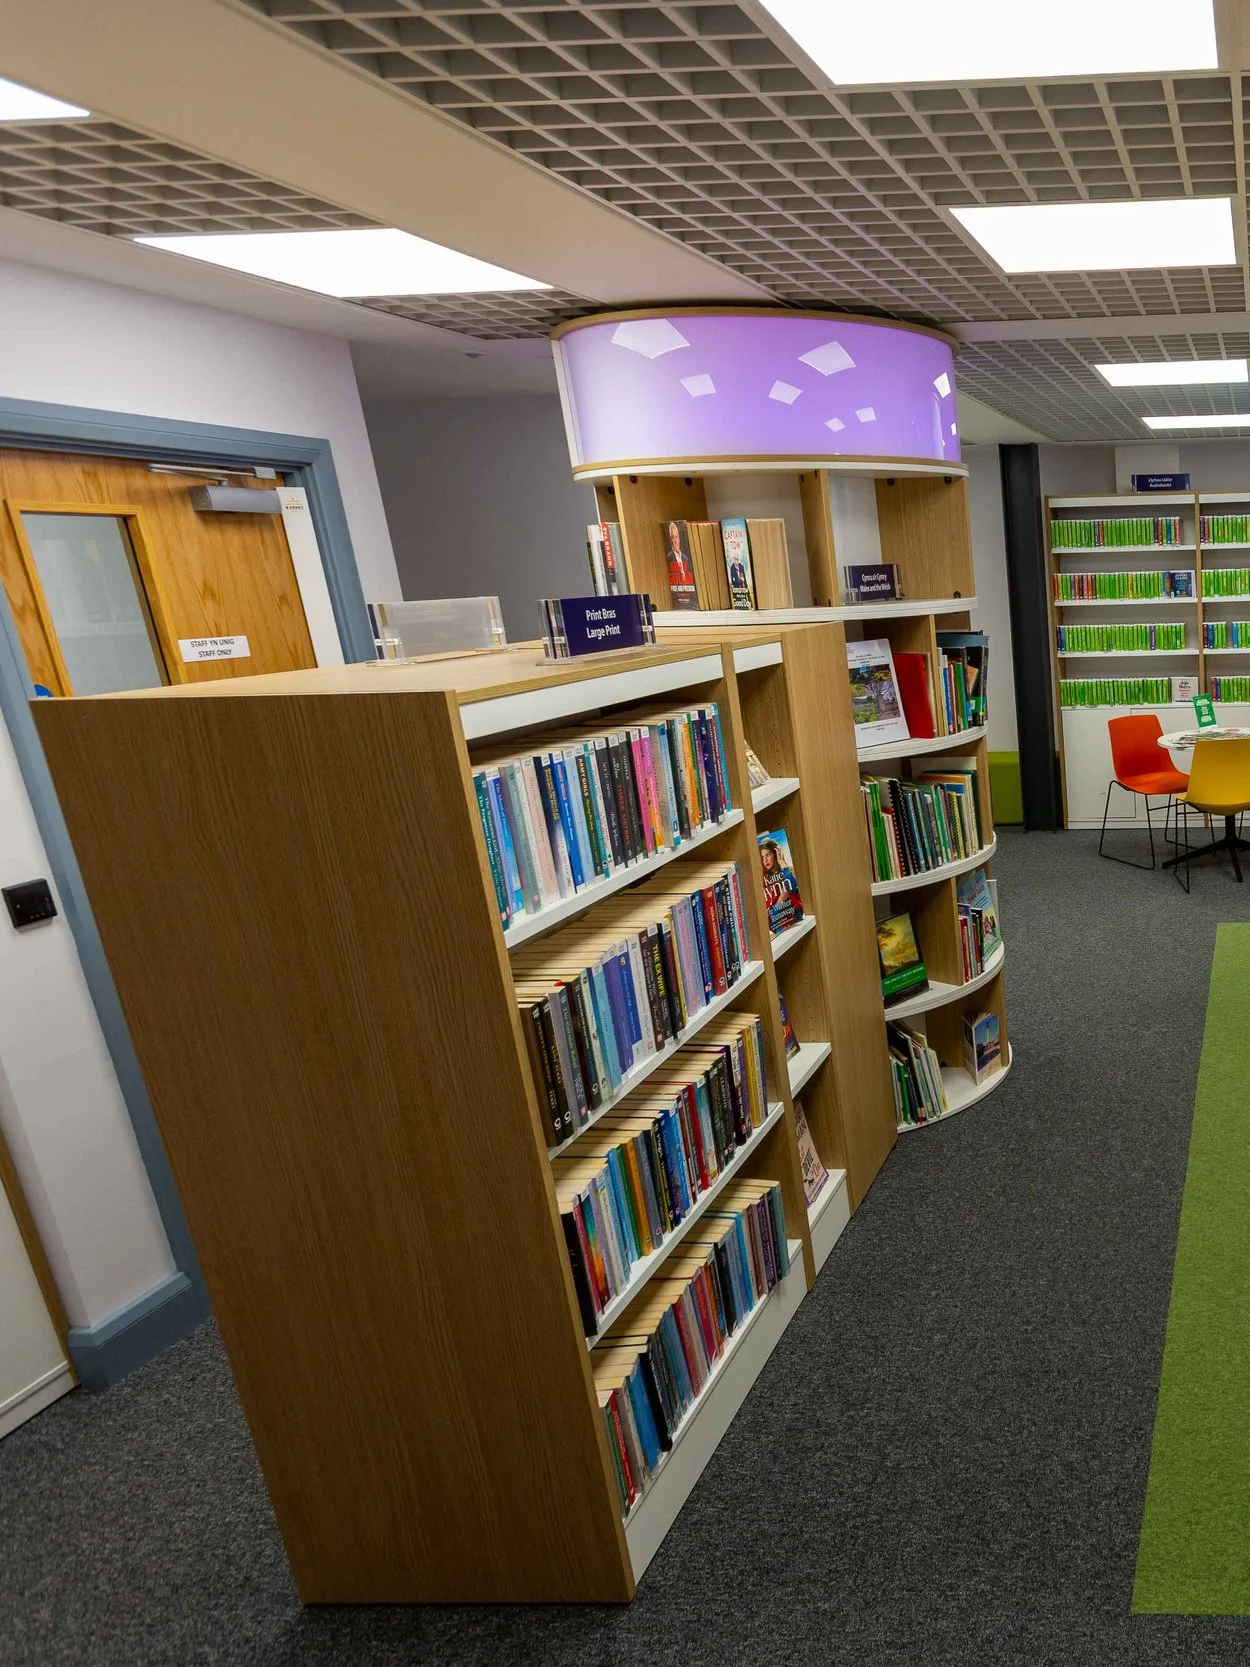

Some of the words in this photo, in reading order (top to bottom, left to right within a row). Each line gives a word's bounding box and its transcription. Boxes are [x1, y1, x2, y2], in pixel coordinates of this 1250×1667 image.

[586, 610, 602, 622] Print
[602, 609, 616, 619] Bras
[586, 626, 605, 640] Large
[605, 625, 621, 637] Print
[191, 640, 208, 648] STAFF
[209, 639, 218, 647] YN
[219, 638, 235, 646] UNIG
[198, 650, 216, 658] STAFF
[217, 649, 232, 657] ONLY
[764, 871, 785, 884] Katie
[773, 899, 792, 912] Winter
[770, 907, 795, 922] Runaway
[651, 943, 660, 963] THE
[653, 961, 662, 977] EX
[655, 973, 666, 999] WIFE
